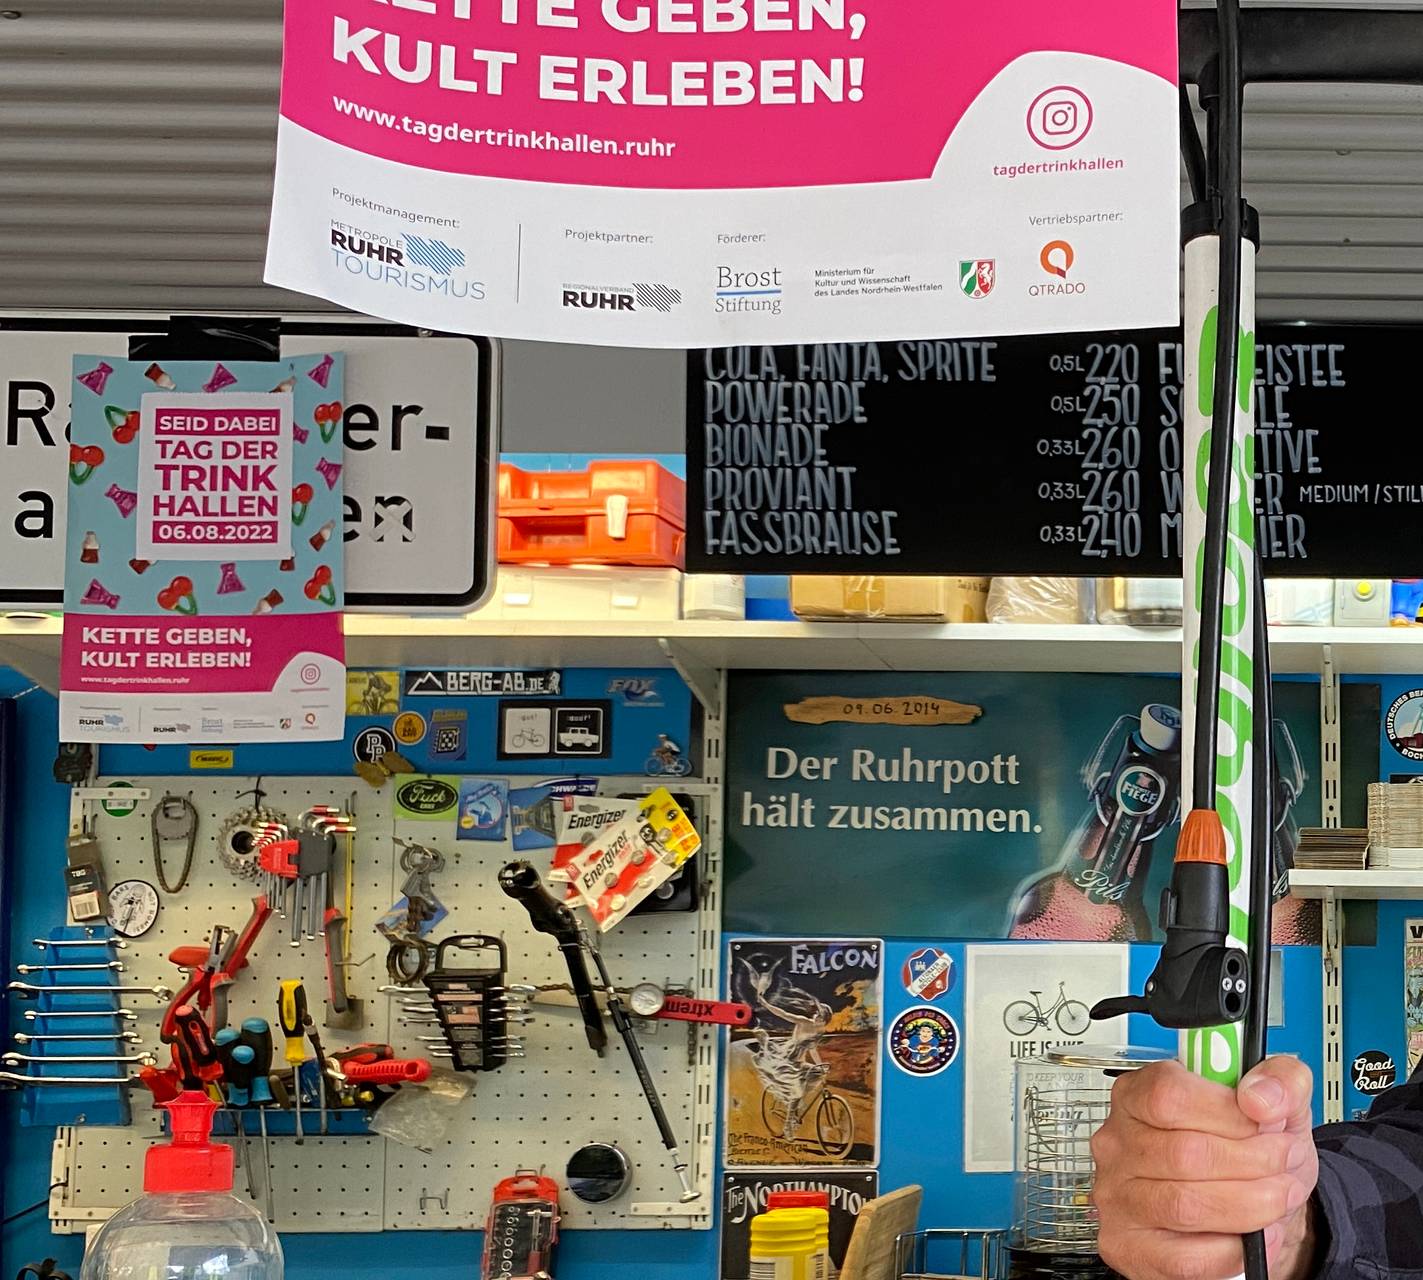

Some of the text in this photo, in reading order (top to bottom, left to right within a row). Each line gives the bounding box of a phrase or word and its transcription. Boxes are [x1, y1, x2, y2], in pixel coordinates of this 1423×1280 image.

[602, 0, 867, 40] GEBEN,
[333, 15, 865, 106] KULT ERLEBEN!
[332, 95, 677, 158] www.tagdertrinkhallen.ruhr
[992, 157, 1125, 179] tagdertrinkhallen
[332, 187, 461, 229] Projektmanagement:
[1028, 210, 1124, 227] Vertriebspartner:
[330, 219, 403, 249] METROPOLE
[565, 228, 654, 244] Projektpartner:
[717, 231, 766, 244] Förderer:
[330, 229, 405, 267] RUHR
[331, 247, 487, 301] TOURISMUS
[716, 265, 782, 289] Brost
[815, 267, 875, 279] Ministerium für
[815, 274, 911, 288] Kultur und Wissenschaft
[562, 290, 637, 312] RUHR
[814, 282, 943, 298] des Landes Nordrhein-Westfalen
[1028, 282, 1086, 297] QTRADO
[714, 297, 782, 315] Stiftung
[897, 340, 998, 383] SPRITE
[703, 380, 868, 425] POWERADE
[159, 415, 277, 432] SEID DABEI
[155, 439, 278, 460] TAG DER
[703, 423, 830, 468] BIONADE
[154, 463, 279, 493] TRINK
[703, 466, 857, 511] PROVIANT
[1300, 484, 1369, 503] MEDIUM
[152, 494, 279, 518] HALLEN
[158, 524, 273, 541] 06.08.2022
[703, 510, 901, 556] FASSBRAUSE
[82, 626, 252, 648] KETTE GEBEN,
[80, 651, 251, 669] KULT ERLEBEN!
[446, 671, 545, 693] BERG-AB.DE
[1386, 694, 1409, 741] DEUTSCHES
[766, 747, 1020, 793] Der Ruhrpott
[1121, 782, 1159, 805] FIEGE
[568, 809, 627, 830] Energizer
[741, 792, 1043, 835] hält zusammen.
[581, 829, 630, 890] Energizer
[1074, 869, 1131, 901] Pils
[790, 944, 878, 975] FALCON
[1010, 1041, 1036, 1058] LIFE
[1353, 1056, 1396, 1076] Good
[1353, 1074, 1395, 1091] Roll
[725, 1185, 744, 1213] The
